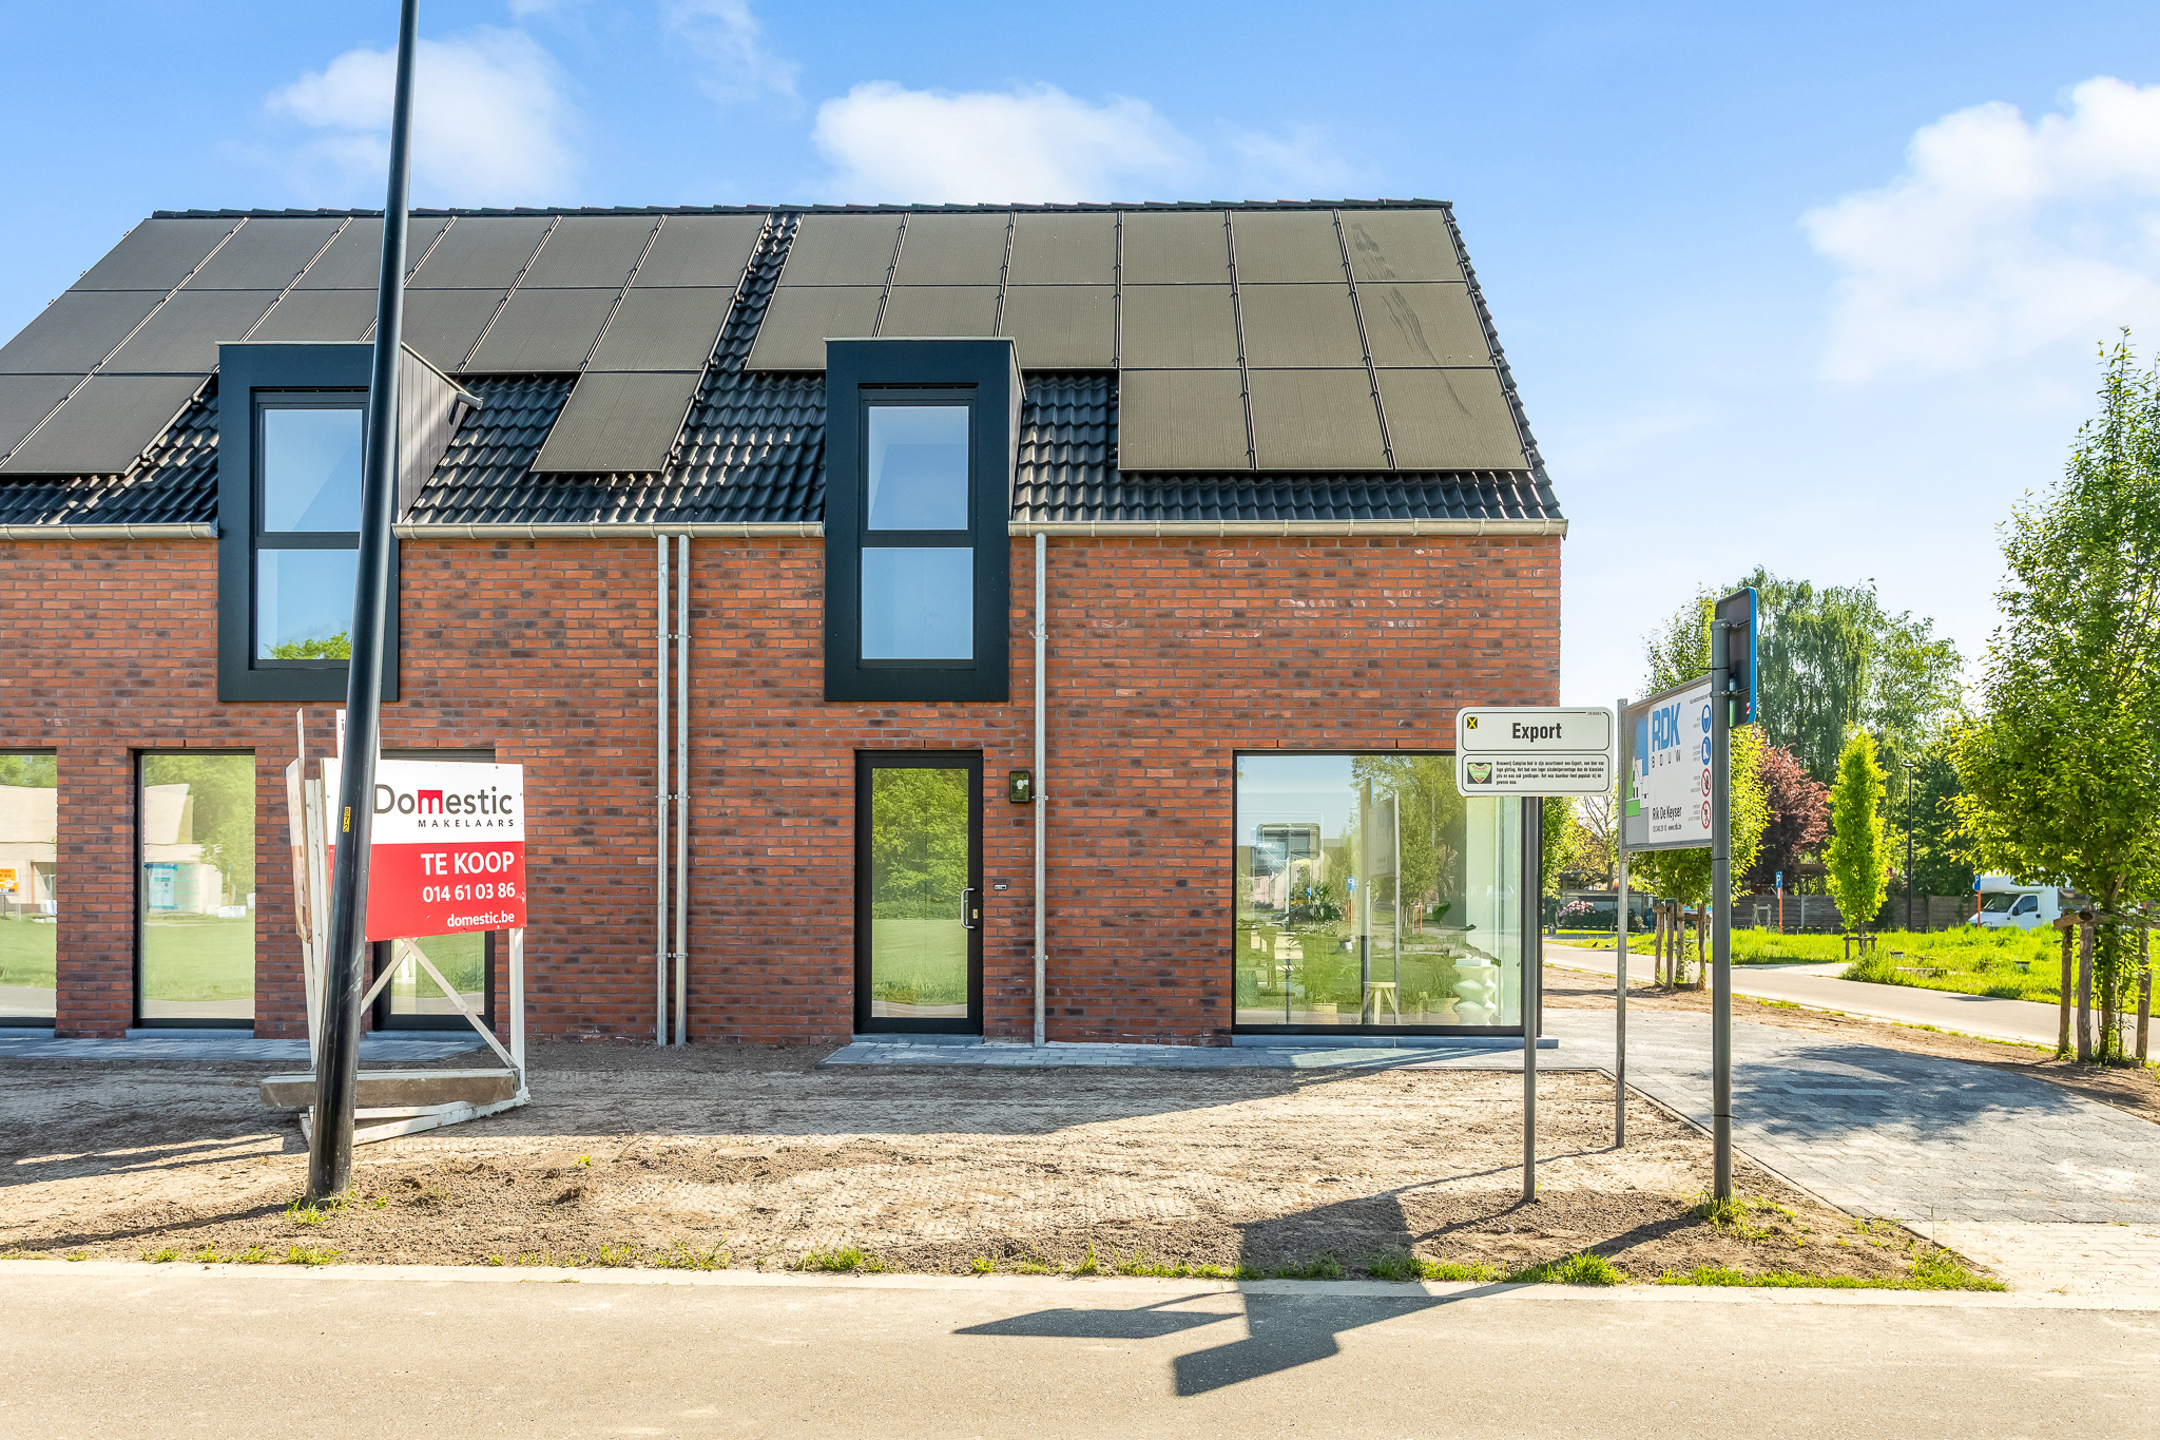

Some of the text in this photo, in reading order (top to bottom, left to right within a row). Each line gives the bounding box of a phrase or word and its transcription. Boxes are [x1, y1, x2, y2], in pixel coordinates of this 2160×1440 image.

[1512, 722, 1562, 743] Export
[1652, 702, 1681, 752] RDK
[1652, 749, 1681, 768] BOUW
[374, 784, 513, 814] Domestic
[418, 819, 514, 827] MAKELAARS
[1660, 806, 1666, 819] De
[1666, 806, 1682, 821] Keyser
[420, 851, 515, 875] TE KOOP
[422, 882, 516, 902] 014 61 03 86
[447, 910, 515, 927] domestic.be
